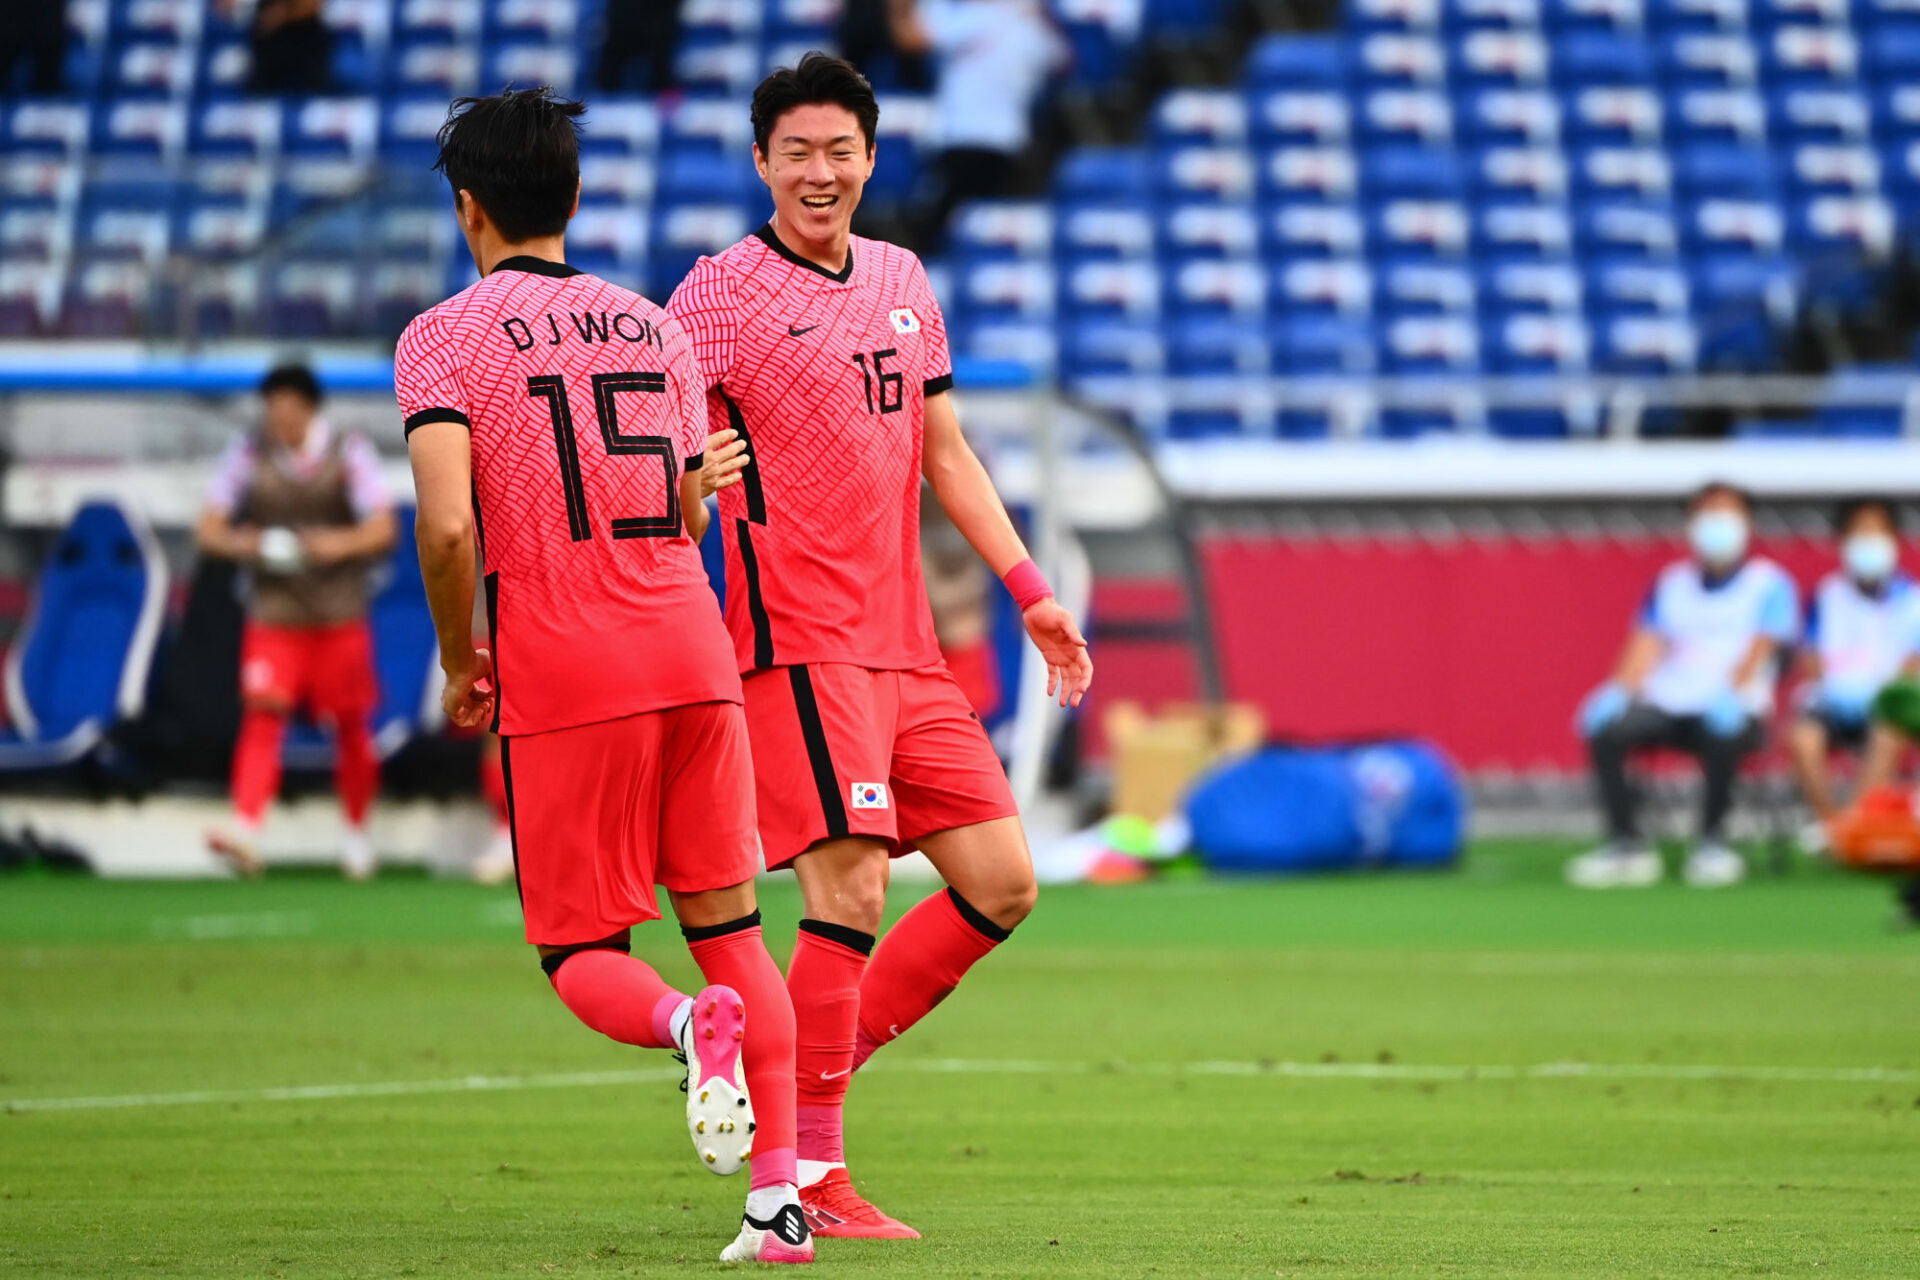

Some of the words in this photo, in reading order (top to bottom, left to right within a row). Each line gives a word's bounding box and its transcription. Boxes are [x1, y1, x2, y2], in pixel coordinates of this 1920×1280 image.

[569, 311, 663, 352] WON
[852, 348, 903, 415] 16
[527, 371, 682, 543] 15
